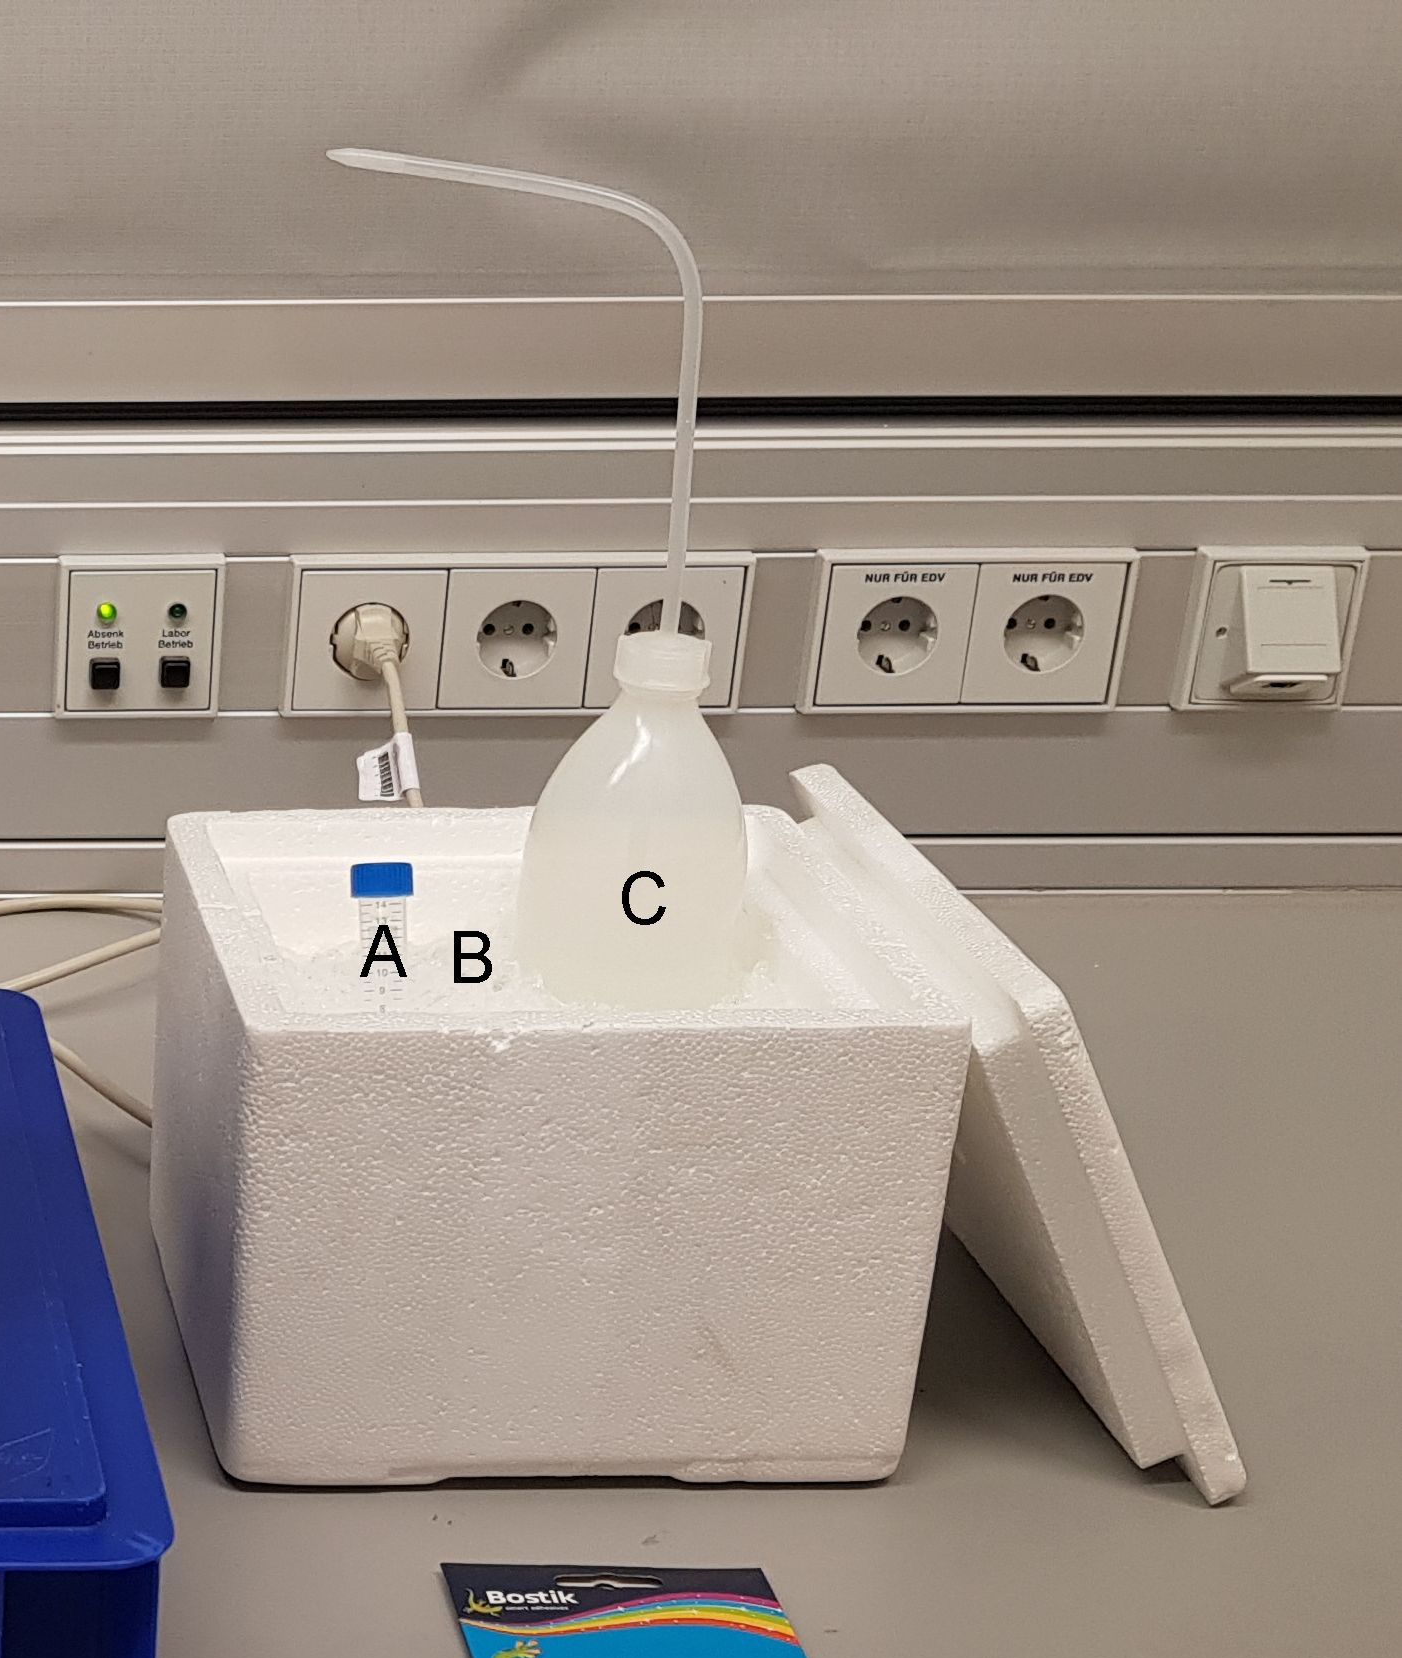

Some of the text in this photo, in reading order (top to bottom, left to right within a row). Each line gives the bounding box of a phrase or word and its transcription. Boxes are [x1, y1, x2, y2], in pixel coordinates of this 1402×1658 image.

[864, 571, 947, 583] NUR FÜR EDV
[1012, 571, 1094, 583] NUR FÜR EDV
[87, 630, 124, 639] Absenk
[162, 629, 191, 638] Labor
[88, 640, 123, 650] Betrieb
[158, 639, 194, 649] Betrieb
[486, 1590, 579, 1604] Bostik
